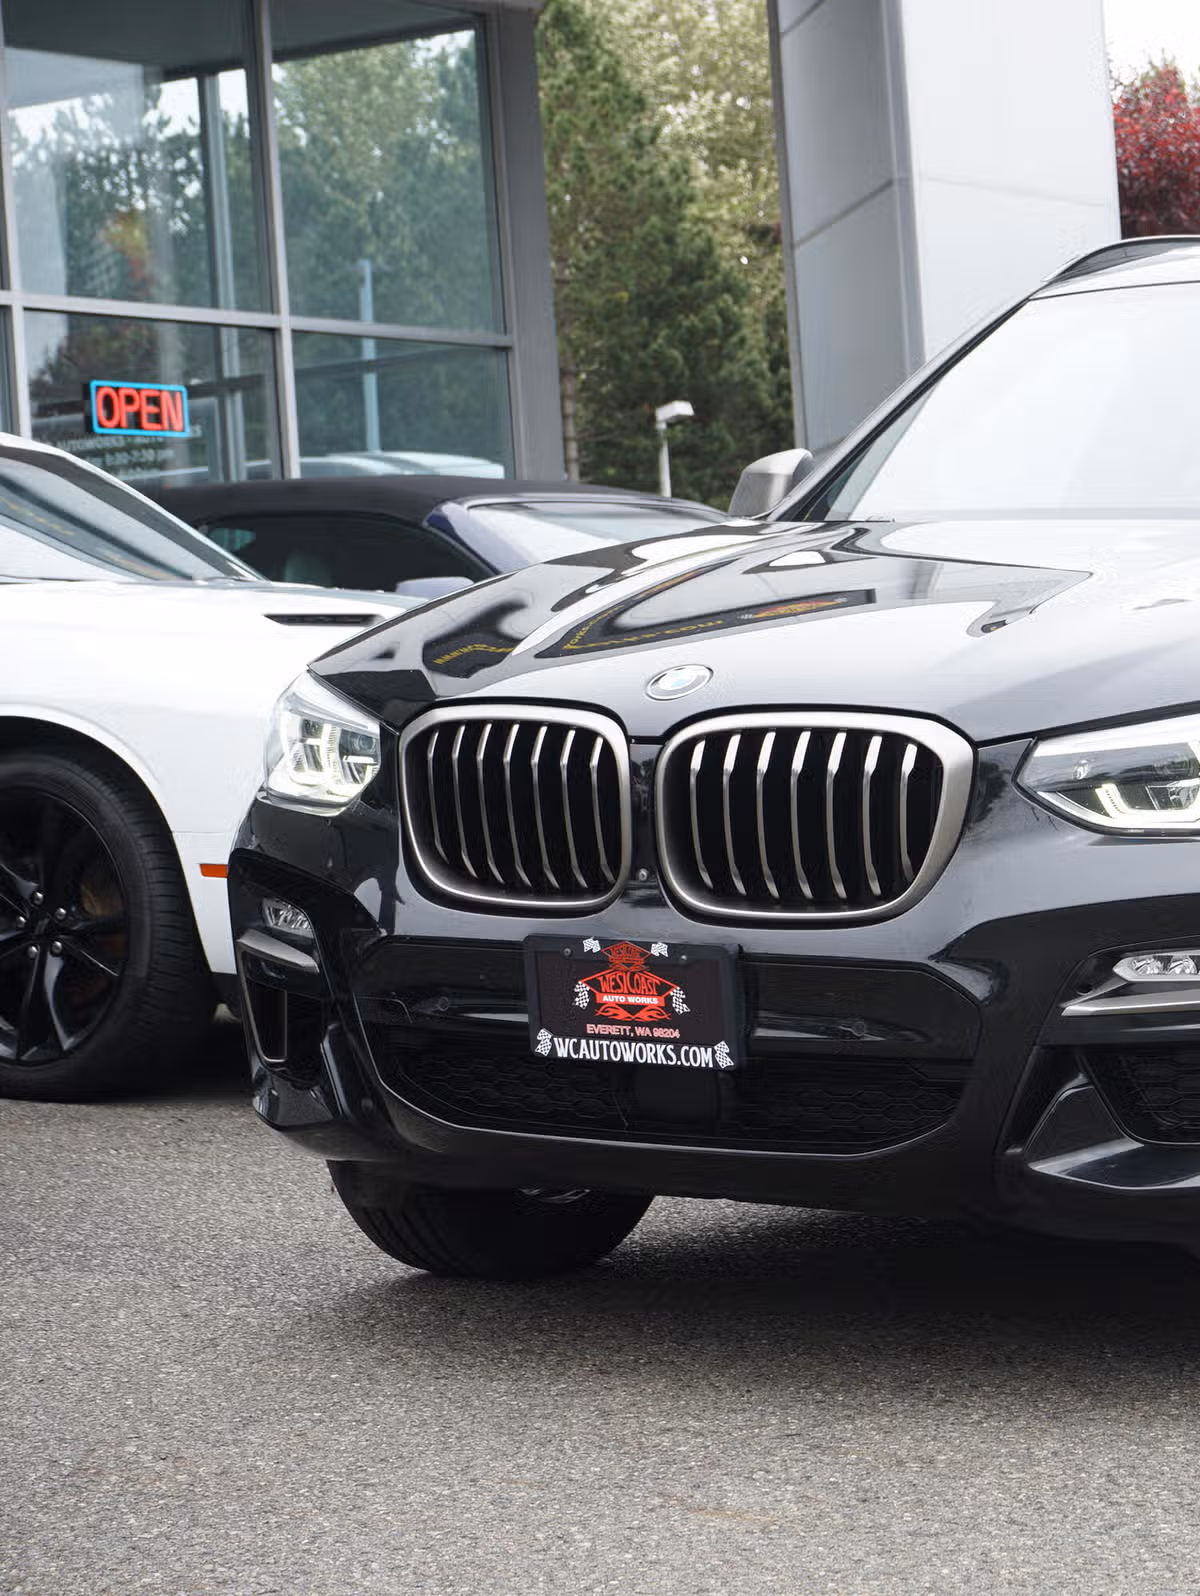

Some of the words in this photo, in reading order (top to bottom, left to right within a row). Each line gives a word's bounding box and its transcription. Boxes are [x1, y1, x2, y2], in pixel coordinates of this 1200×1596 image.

[95, 386, 184, 432] OPEN
[602, 995, 626, 1003] AUTO
[627, 996, 659, 1004] WORKS
[586, 1023, 634, 1037] EVERETT,
[634, 1026, 652, 1037] WA
[652, 1027, 680, 1039] 98204
[553, 1037, 714, 1068] WCAUTOWORKS.COM
